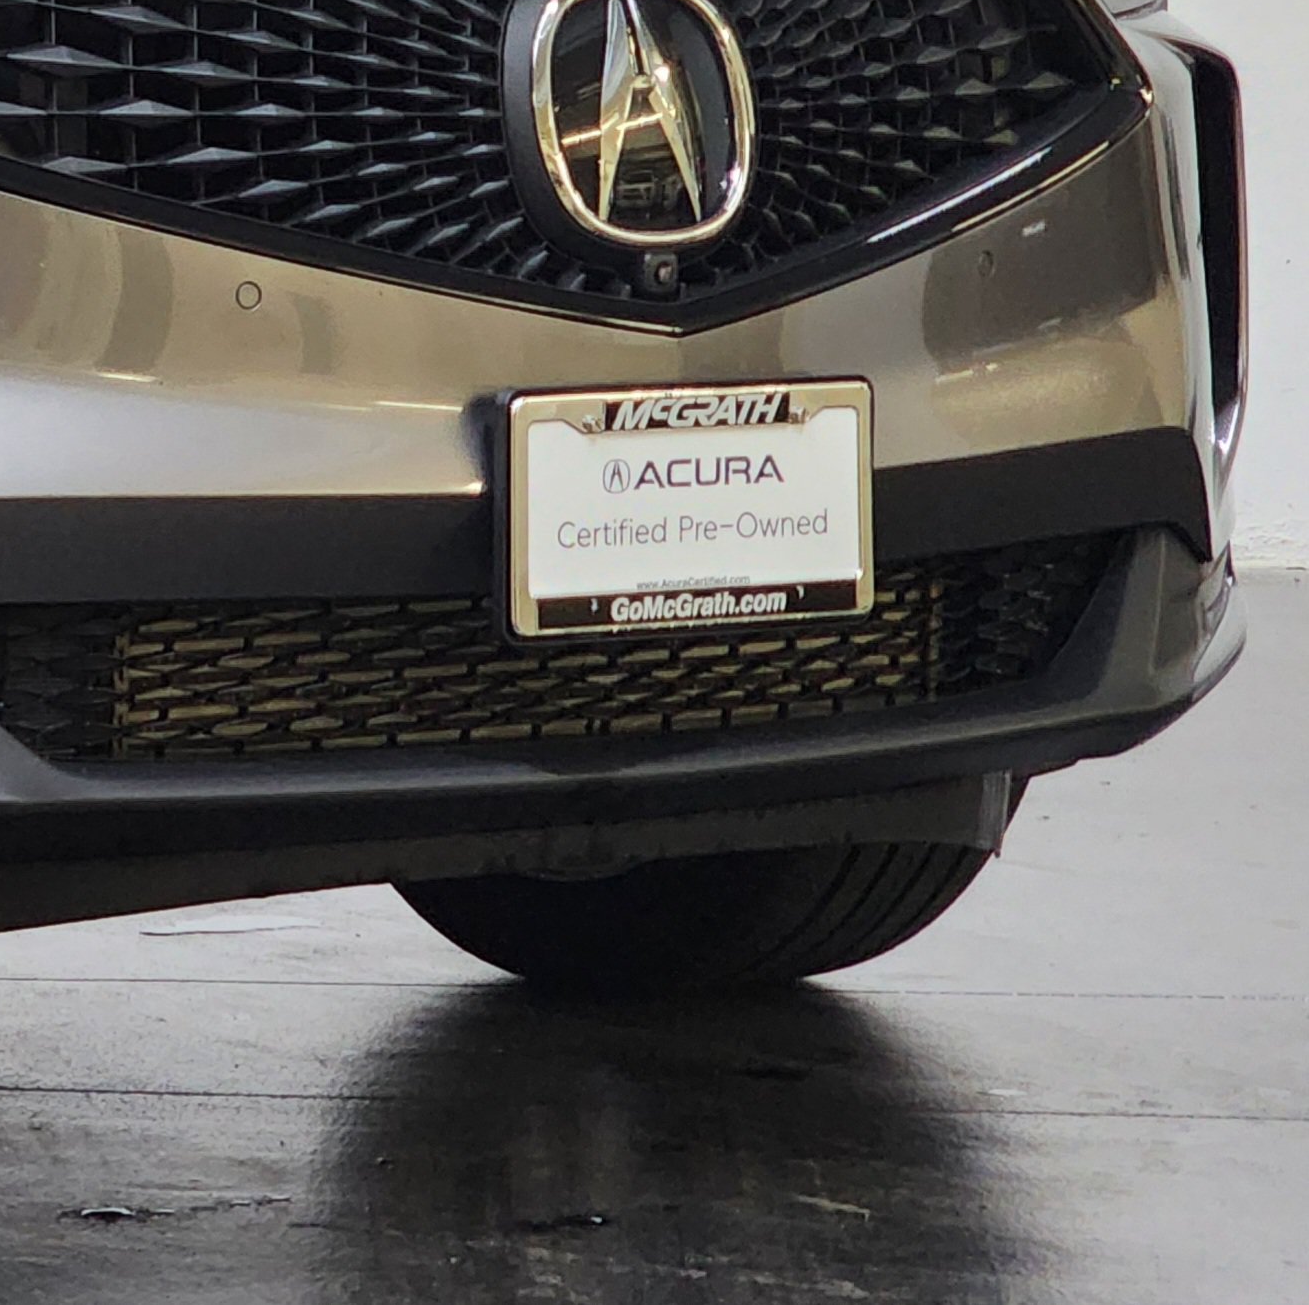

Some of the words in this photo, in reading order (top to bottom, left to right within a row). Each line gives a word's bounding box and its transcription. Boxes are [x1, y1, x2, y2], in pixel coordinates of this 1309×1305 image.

[634, 454, 785, 490] ACURA
[557, 517, 667, 548] Certified
[679, 508, 829, 543] Pre-Owned
[610, 591, 787, 623] GoMcGrath.com
